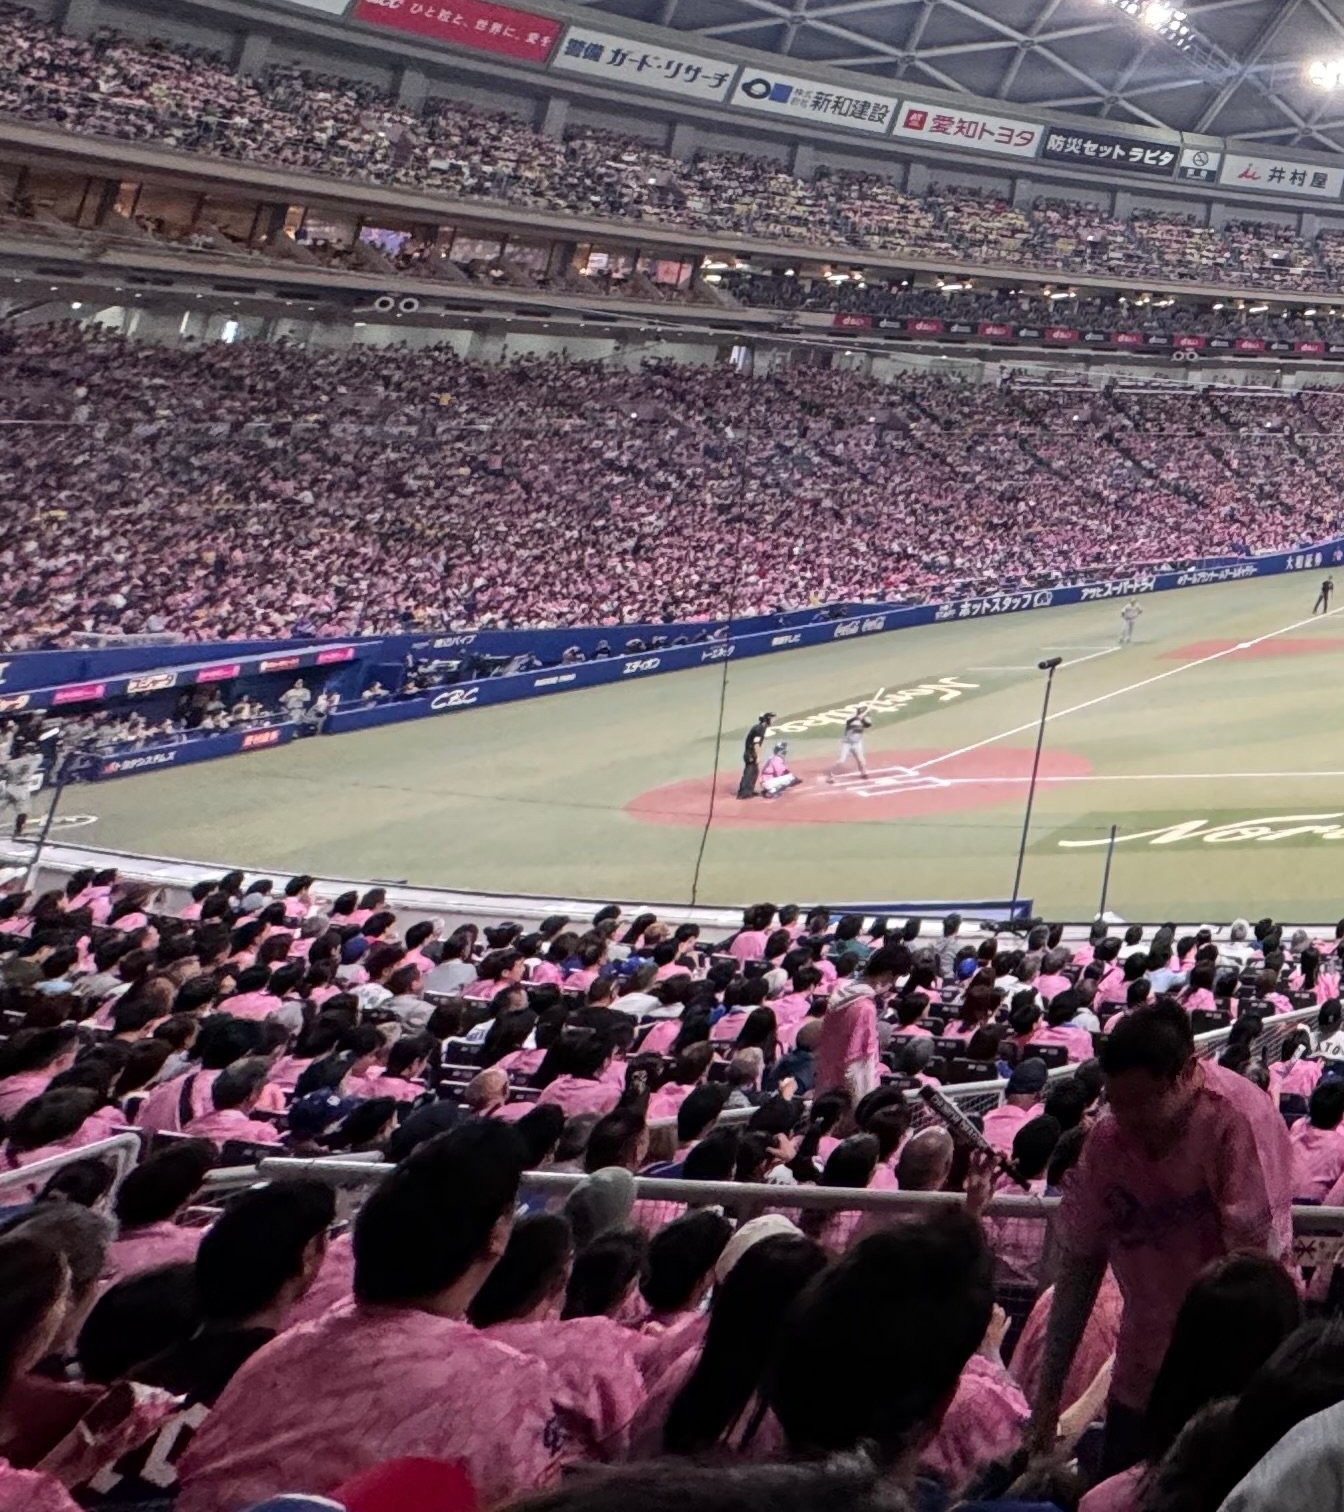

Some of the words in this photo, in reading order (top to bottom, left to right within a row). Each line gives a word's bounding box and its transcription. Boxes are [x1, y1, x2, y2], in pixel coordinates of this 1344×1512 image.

[809, 90, 890, 125] 新和建設
[928, 113, 1036, 148] 愛知トヨタ
[1046, 134, 1126, 160] 防災セット
[1267, 165, 1329, 189] 井村屋
[958, 592, 1037, 618] ホットスタッフ
[431, 687, 480, 710] CBC
